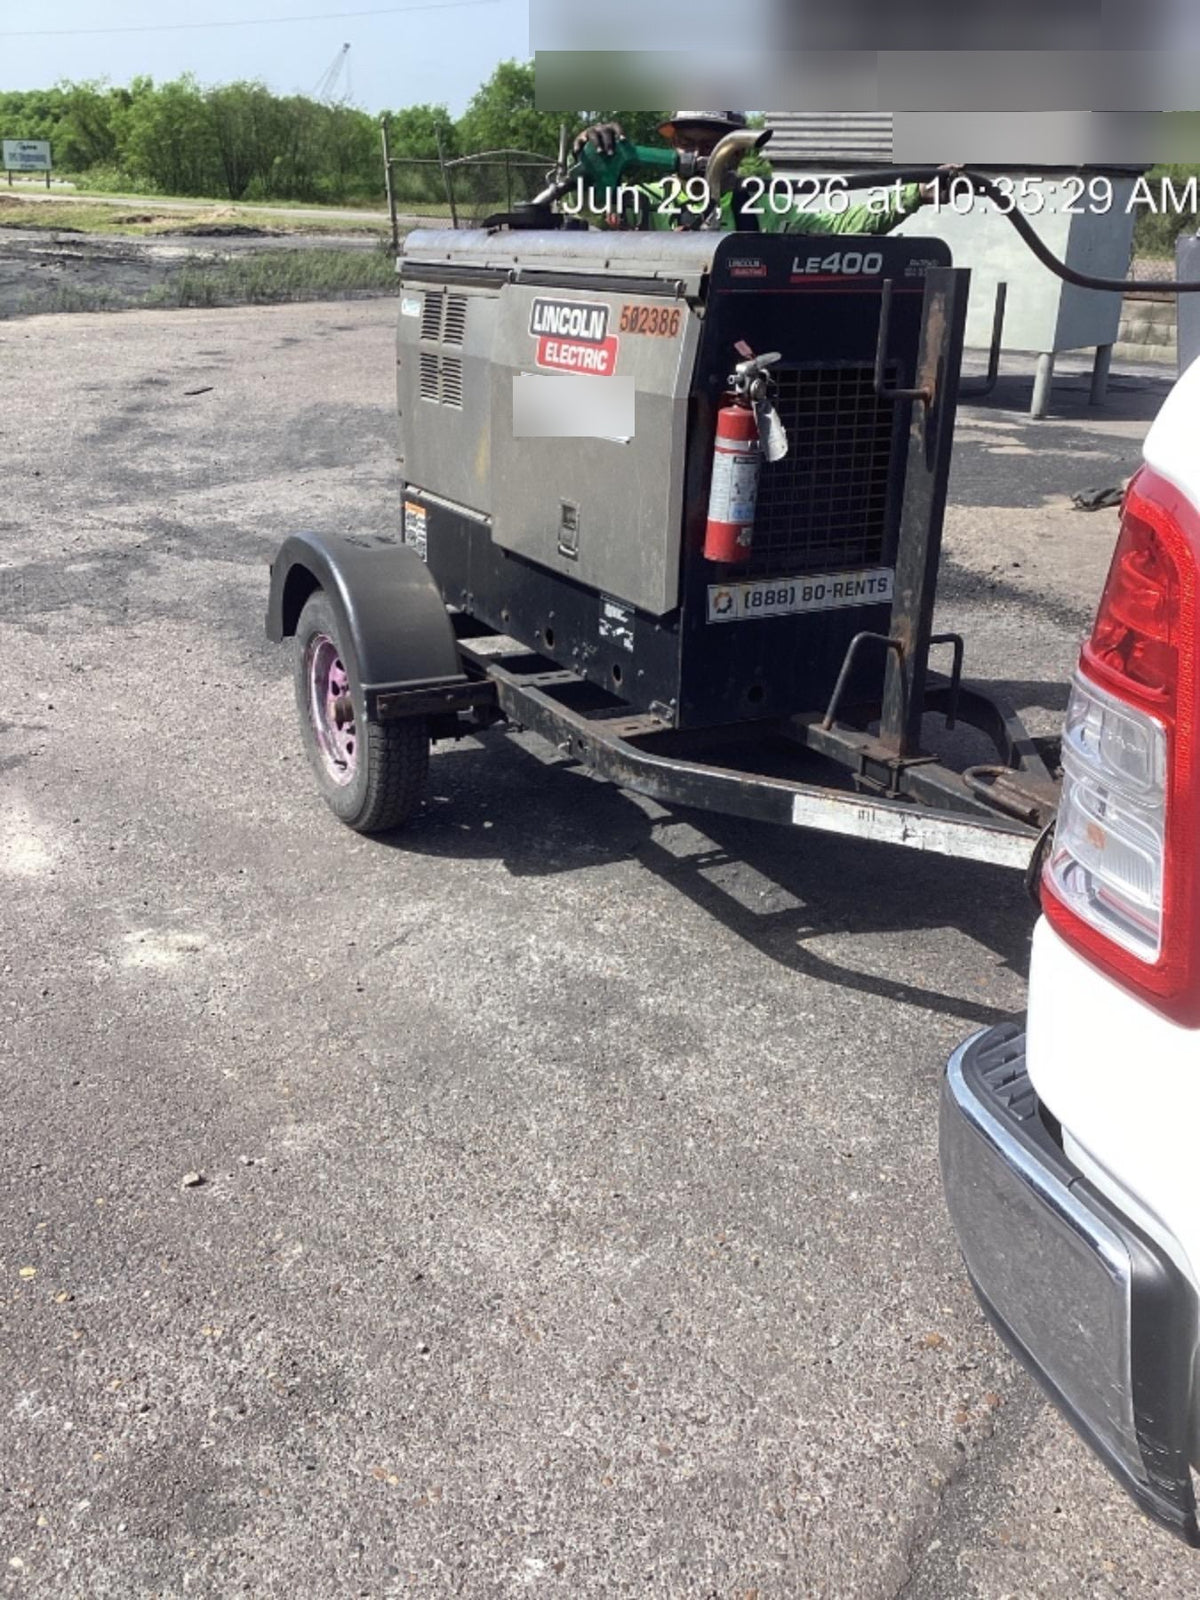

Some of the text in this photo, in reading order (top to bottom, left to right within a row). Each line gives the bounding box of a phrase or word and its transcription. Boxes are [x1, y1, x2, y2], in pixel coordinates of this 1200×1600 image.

[792, 252, 883, 275] LE400
[533, 304, 606, 340] LINCOLN
[619, 305, 681, 336] 502386
[544, 341, 609, 371] ELECTRIC
